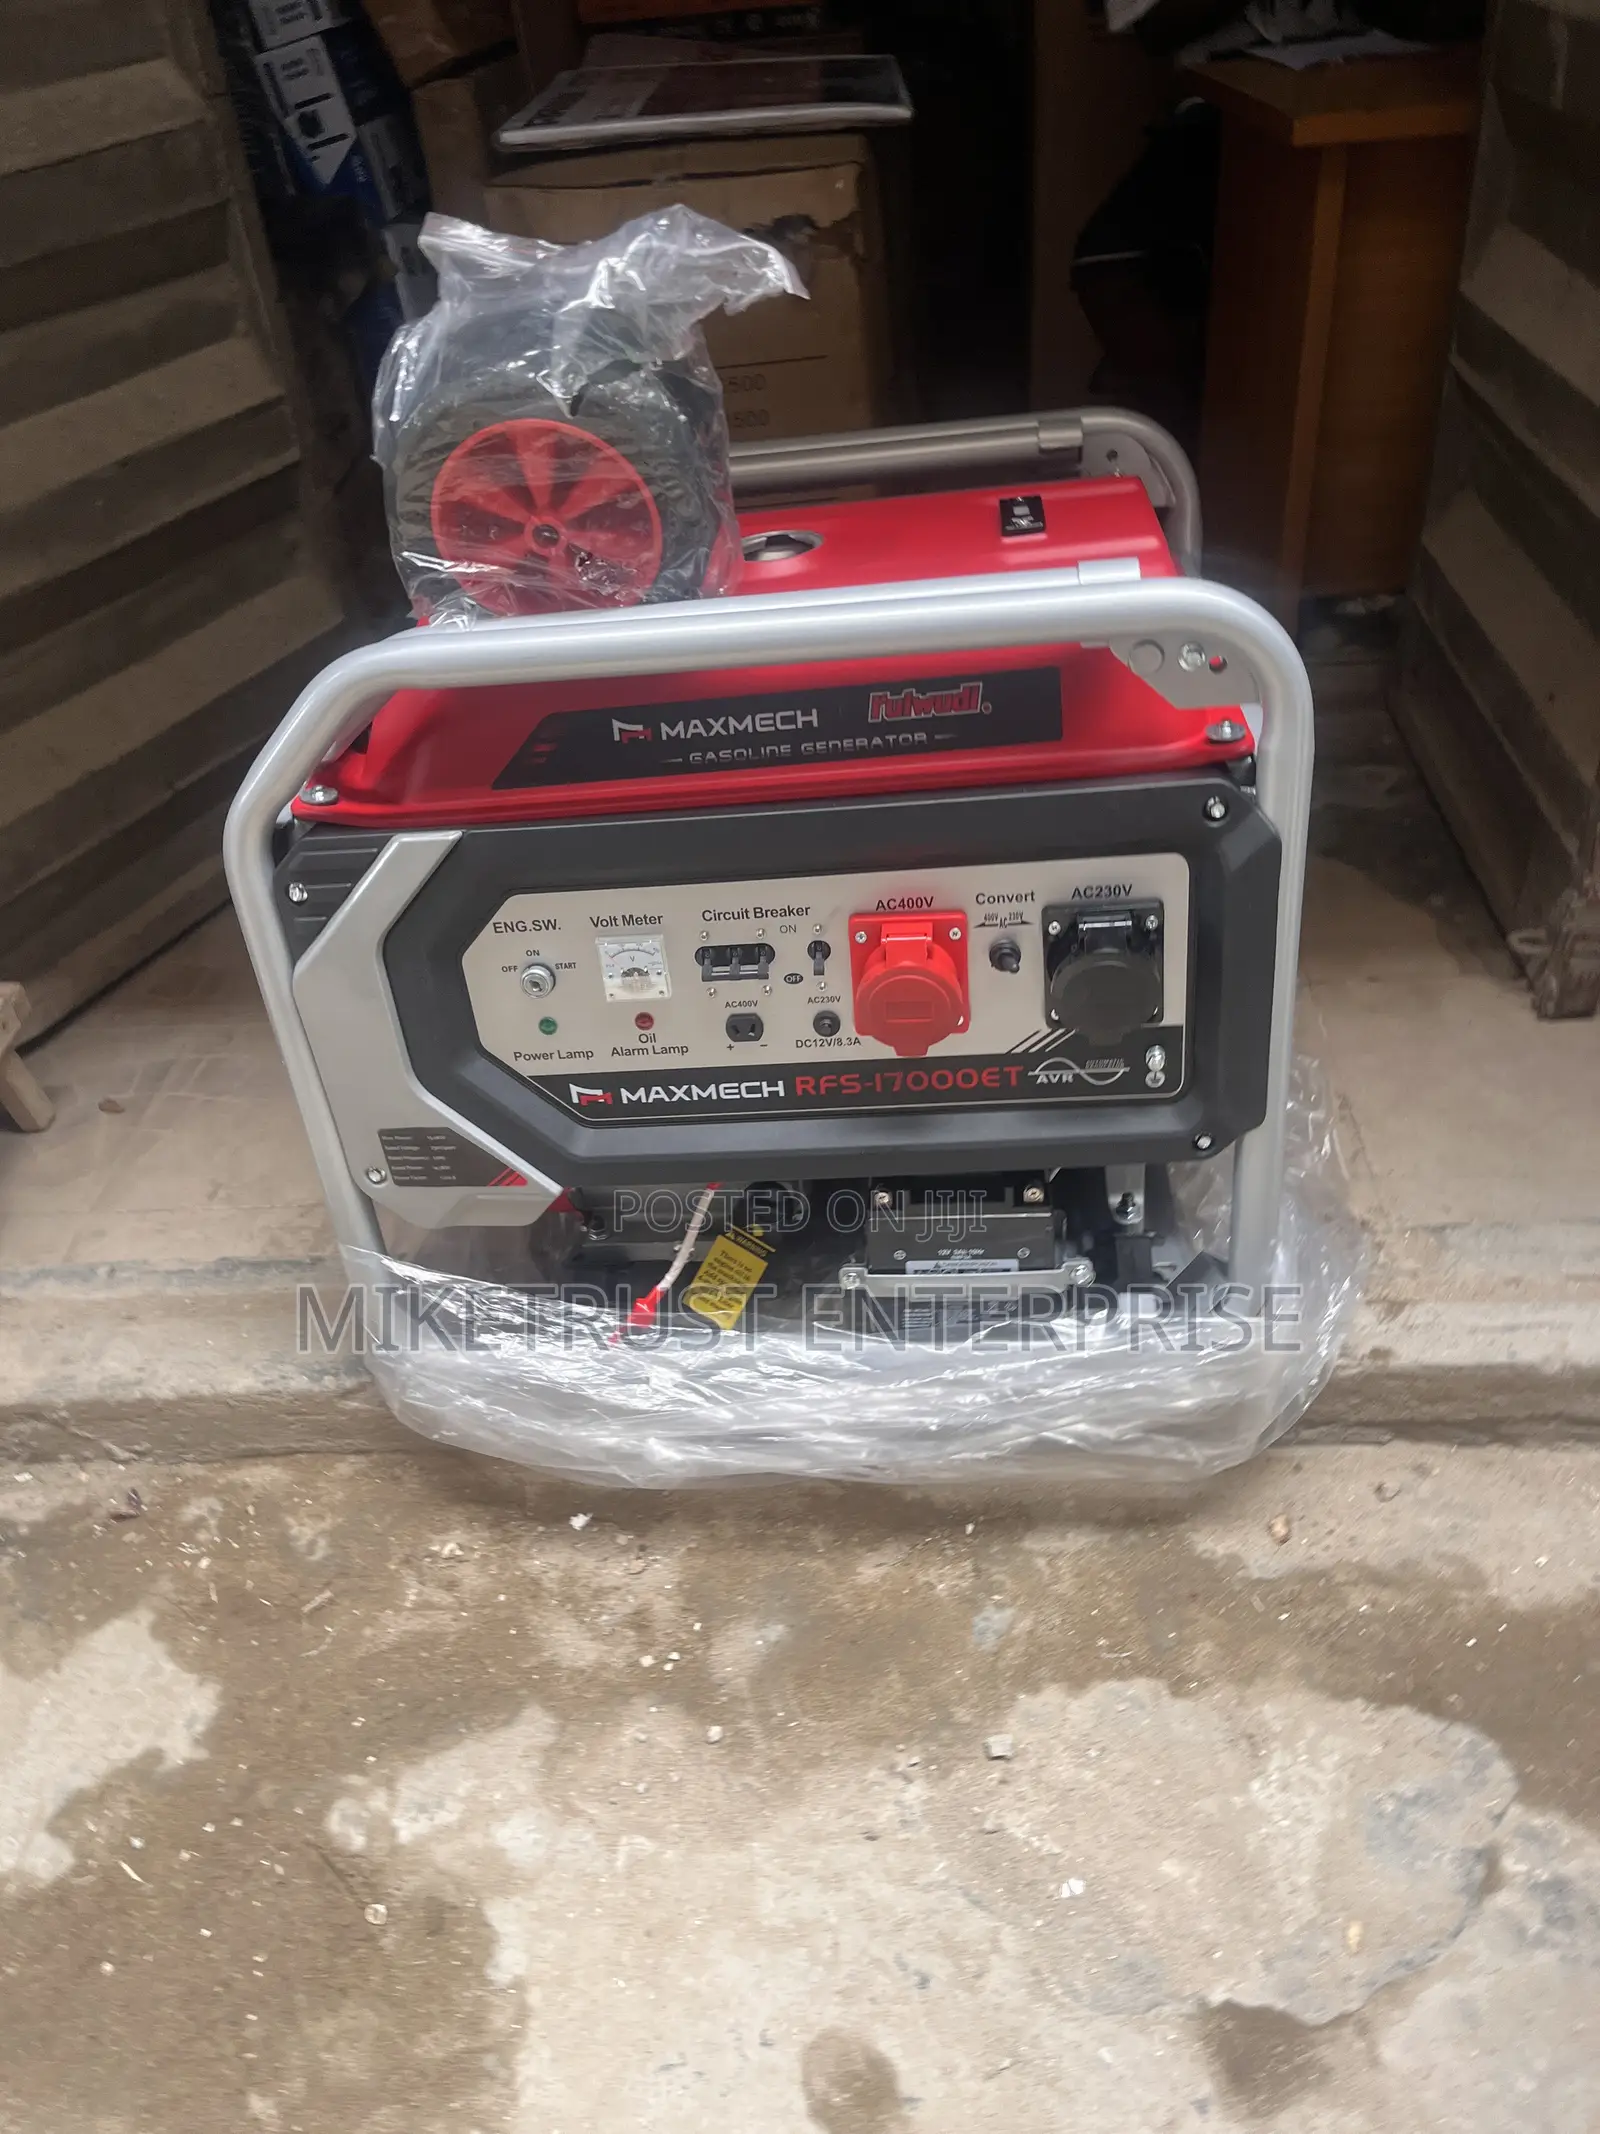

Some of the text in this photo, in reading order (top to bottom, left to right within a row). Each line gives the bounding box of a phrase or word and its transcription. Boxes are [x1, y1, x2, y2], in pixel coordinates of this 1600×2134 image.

[660, 708, 819, 741] MAXMECH
[689, 732, 927, 764] GASOLINE GENERATOR
[975, 890, 1035, 905] Convert
[1071, 884, 1133, 900] AC230V
[876, 896, 934, 911] AC400V
[701, 905, 811, 921] Circuit Breaker
[493, 919, 561, 934] ENG.SW.
[590, 913, 664, 928] Volt Meter
[779, 924, 797, 934] ON
[525, 949, 540, 957] ON
[555, 962, 577, 970] START
[785, 975, 801, 984] OFF
[724, 1000, 758, 1009] AC400V
[807, 995, 841, 1004] AC230V
[638, 1033, 656, 1044] Oil
[795, 1036, 861, 1048] DC12V/8.3A
[513, 1049, 594, 1062] Power Lamp
[610, 1044, 689, 1057] Alarm Lamp
[795, 1065, 1024, 1096] RFS-17000ET
[1036, 1073, 1074, 1085] AVR
[620, 1080, 785, 1104] MAXMECH
